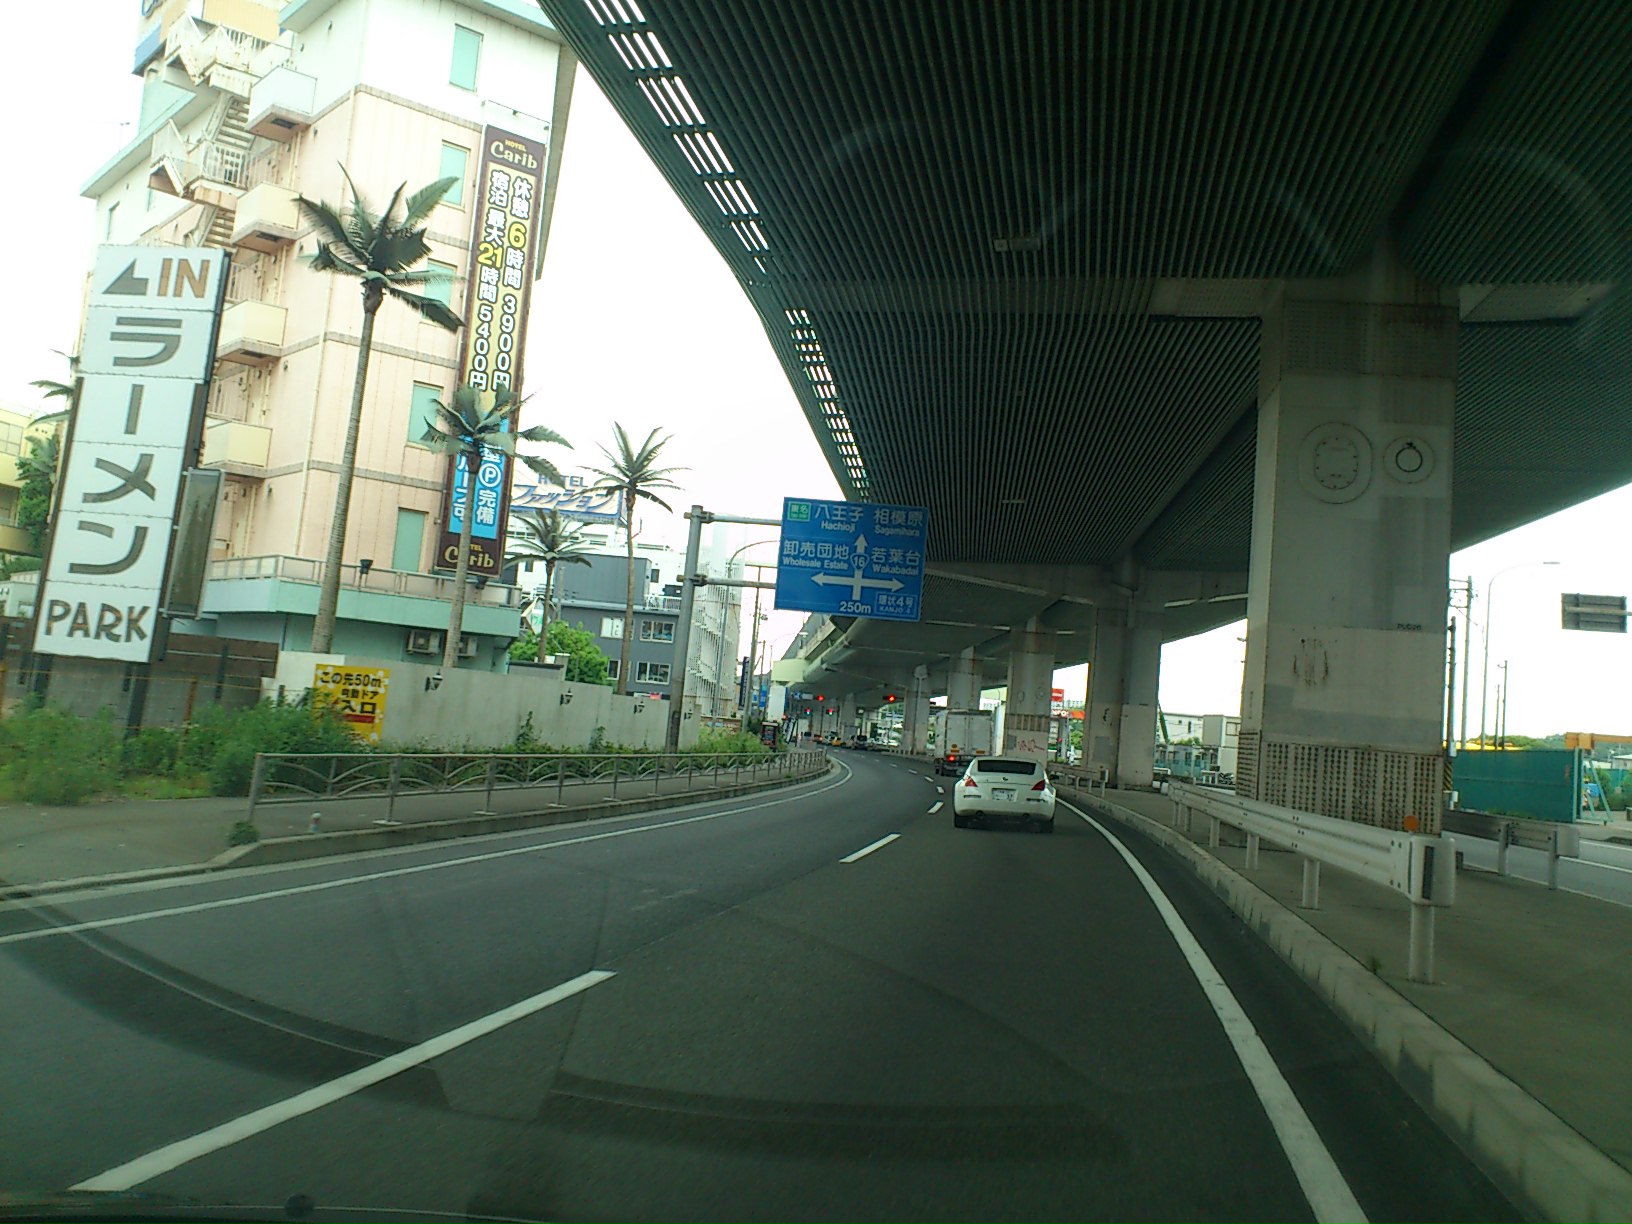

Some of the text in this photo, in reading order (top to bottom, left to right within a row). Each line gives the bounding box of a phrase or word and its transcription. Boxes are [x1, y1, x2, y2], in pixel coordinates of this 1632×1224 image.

[505, 139, 527, 152] HOTEL
[490, 140, 538, 170] Carib
[156, 257, 211, 299] IN
[67, 315, 184, 576] ラーメン
[538, 473, 588, 488] HTEL
[512, 484, 615, 511] ファッション
[815, 504, 864, 521] 八王子
[874, 508, 923, 527] 相模原
[821, 521, 856, 533] Hachioji
[875, 525, 920, 537] Sagamihara
[444, 545, 495, 568] Crib
[783, 540, 850, 560] 卸売団地
[871, 547, 921, 566] 若葉台
[782, 557, 849, 570] Wholesale Estate
[854, 557, 865, 567] 16
[872, 563, 919, 576] Wakabadai
[840, 601, 872, 614] 250m
[44, 599, 152, 644] PARK
[320, 671, 382, 688] この先50m
